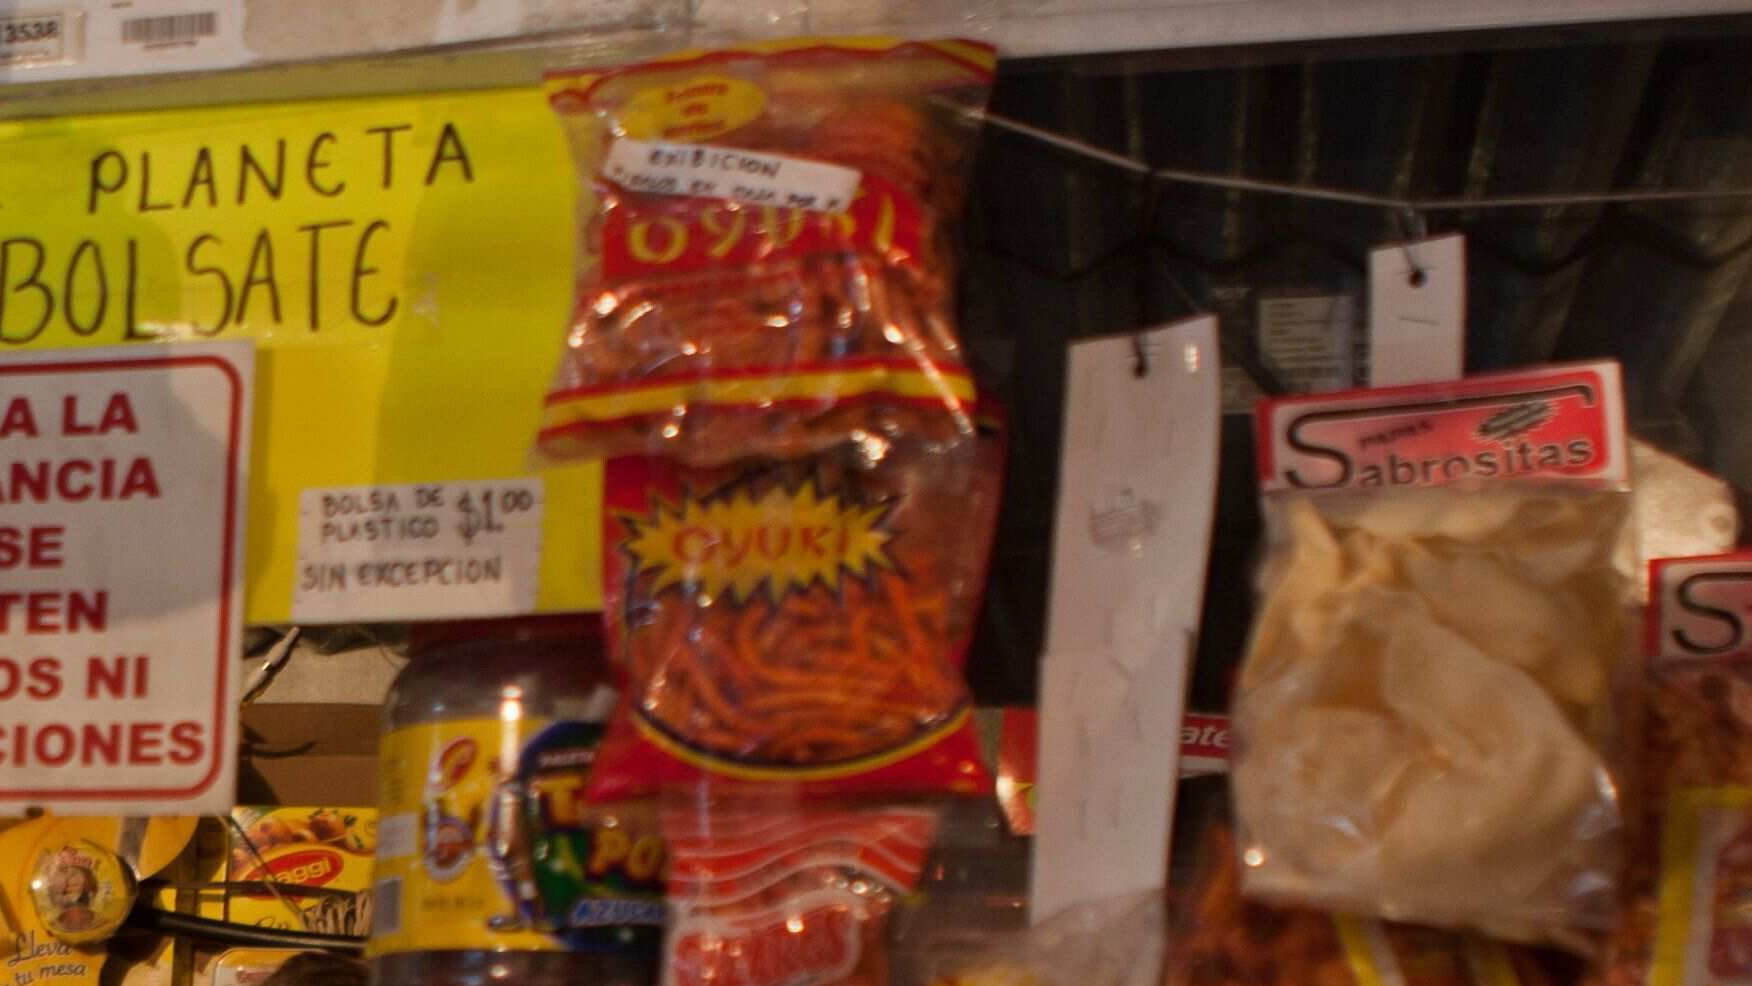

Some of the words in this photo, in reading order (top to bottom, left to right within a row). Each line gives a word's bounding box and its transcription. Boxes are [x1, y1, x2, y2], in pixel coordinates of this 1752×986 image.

[88, 122, 475, 214] PLANETA
[62, 393, 139, 436] LA
[1284, 383, 1593, 489] Sabrositas
[322, 490, 401, 518] BOLSA
[415, 486, 446, 509] DE
[321, 516, 441, 543] PLASTICO
[301, 561, 346, 592] SIN
[357, 555, 502, 588] EXCEPCION
[86, 656, 149, 699] NI
[8, 929, 72, 966] Lleva
[39, 962, 89, 979] mesa
